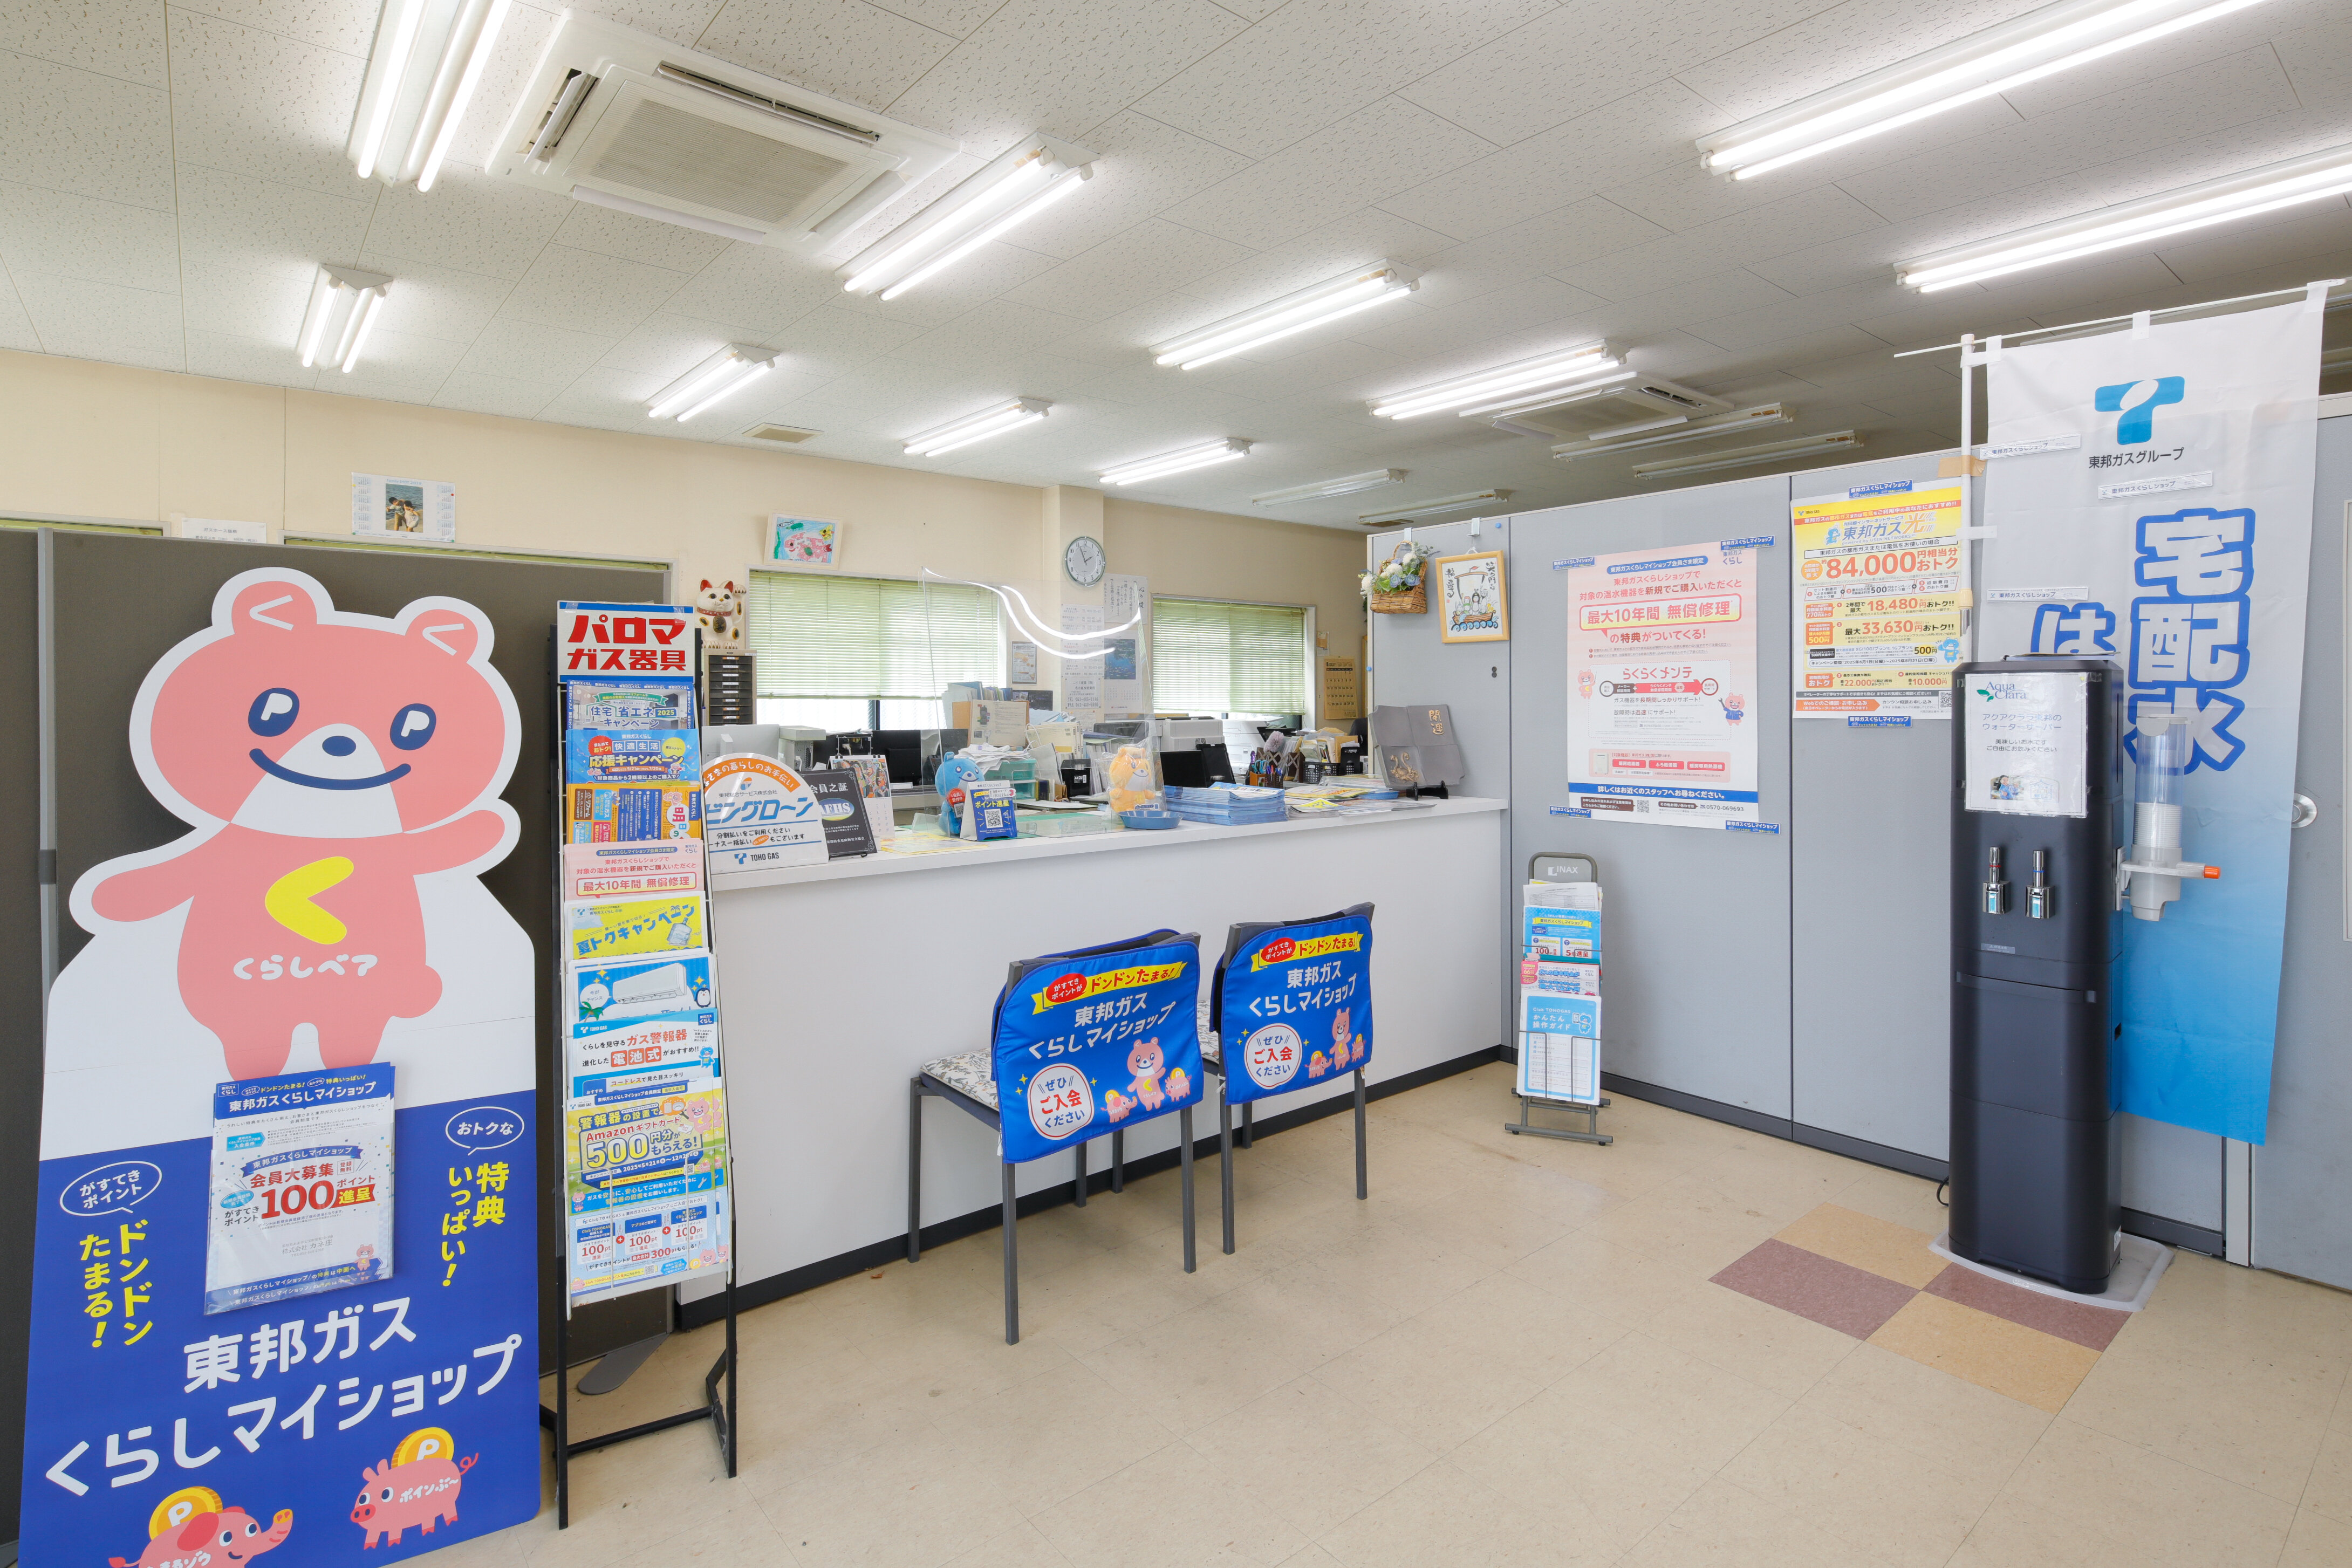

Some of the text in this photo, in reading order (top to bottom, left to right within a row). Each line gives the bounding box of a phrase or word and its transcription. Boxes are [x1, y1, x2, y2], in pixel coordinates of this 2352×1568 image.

[2089, 447, 2184, 469] 東邦ガスグループ
[1820, 539, 1940, 556] 東邦ガスの都市ガスまたは電気をお使いの場合
[1917, 547, 1958, 559] 円相当分
[1610, 557, 1704, 573] 東邦ガスくらしマイショップ会員さま限定
[1722, 557, 1743, 565] くらし
[1826, 551, 1917, 579] 84,000
[1917, 556, 1958, 572] おトク
[1613, 571, 1701, 586] 東邦ガスくらしショップで
[1580, 579, 1742, 601] 対象の温水機器を新規でご購入いただくと
[1868, 598, 1918, 611] 18,480
[1587, 601, 1731, 625] 最大10年間 無償修理
[568, 614, 687, 645] パロマ
[1862, 620, 1913, 635] 33,630
[1610, 628, 1706, 644] の特典がついてくる!
[2124, 508, 2256, 775] 宅配水
[567, 648, 686, 671] ガス器具
[1622, 666, 1693, 680] らくらくメンテ
[1986, 681, 2016, 691] Aqua
[1994, 689, 2027, 700] Clara
[590, 707, 612, 717] 住宅
[619, 706, 654, 717] 省エネ
[1982, 713, 2063, 723] アクアクララ東邦の
[603, 718, 660, 728] キャンペーン
[1429, 710, 1445, 735] 開運
[1982, 722, 2062, 731] ウォーターサーバー
[614, 742, 659, 750] 快適生活
[590, 755, 684, 768] 応援キャンペーン
[719, 790, 778, 798] 東邦総合サービス株式会社
[810, 783, 849, 793] 会員之証
[1597, 785, 1726, 799] 詳しくはお近くのスタッフへお尋ねください。
[975, 800, 1010, 808] ポイント進呈
[1550, 806, 1590, 814] 東邦ガスくらしマイショップ
[1706, 804, 1744, 812] 0570-069693
[717, 827, 790, 839] 分割払いをご利用ください
[1726, 821, 1778, 830] 東邦ガスくらしマイショップ
[770, 834, 805, 843] もございます
[599, 847, 674, 855] 東邦ガスくらしマイショップ会員さま限定
[605, 857, 669, 865] 東邦ガスくらしショップで
[583, 877, 689, 892] 最大10年間 無償修理
[576, 904, 695, 956] 夏トクキャンペーン
[1265, 947, 1293, 960] ポイントが
[1268, 941, 1290, 954] がすてき
[1299, 937, 1356, 956] ドンドンたまる!
[232, 953, 379, 982] くらしベア
[1287, 960, 1342, 989] 東邦ガス
[1053, 978, 1080, 994] がすてき
[1090, 968, 1174, 994] ドンドンたまる!
[1051, 984, 1083, 1000] ポイントが
[1249, 973, 1357, 1017] くらしマイショップ
[1074, 992, 1148, 1028] 東邦ガス
[1028, 1001, 1177, 1060] くらしマイショップ
[1533, 1022, 1570, 1030] 操作ガイド
[583, 1029, 687, 1051] くらしを見守るガス警報器
[1263, 1036, 1283, 1046] ぜひ
[582, 1046, 699, 1067] 進化した電池式がおすすめ!!
[1254, 1046, 1293, 1064] ご入会
[325, 1074, 366, 1084] 特典いっぱい!
[1255, 1064, 1291, 1078] ください
[261, 1082, 305, 1093] ドンドンたまる!
[1045, 1076, 1067, 1092] ぜひ
[229, 1081, 377, 1112] 東邦ガスくらしマイショップ
[1040, 1089, 1082, 1114] ご入会
[1044, 1108, 1085, 1128] ください
[457, 1119, 514, 1139] おトクな
[586, 1117, 681, 1142] Amazonギフトカード
[252, 1147, 353, 1169] 東邦ガスくらしマイショップ
[78, 1168, 141, 1197] がすてき
[250, 1163, 334, 1188] 会員大募集
[337, 1175, 375, 1188] ポイント
[82, 1182, 144, 1210] ポイント
[261, 1180, 334, 1219] 100
[338, 1187, 371, 1204] 進呈
[473, 1161, 510, 1227] 特典
[225, 1206, 259, 1218] がすてき
[224, 1215, 259, 1227] ポイント
[441, 1165, 471, 1288] いっぱい!
[119, 1217, 153, 1346] ドンドン
[79, 1233, 113, 1348] たまる!
[183, 1296, 417, 1394] 東邦ガス
[45, 1332, 523, 1498] くらしマイショップ
